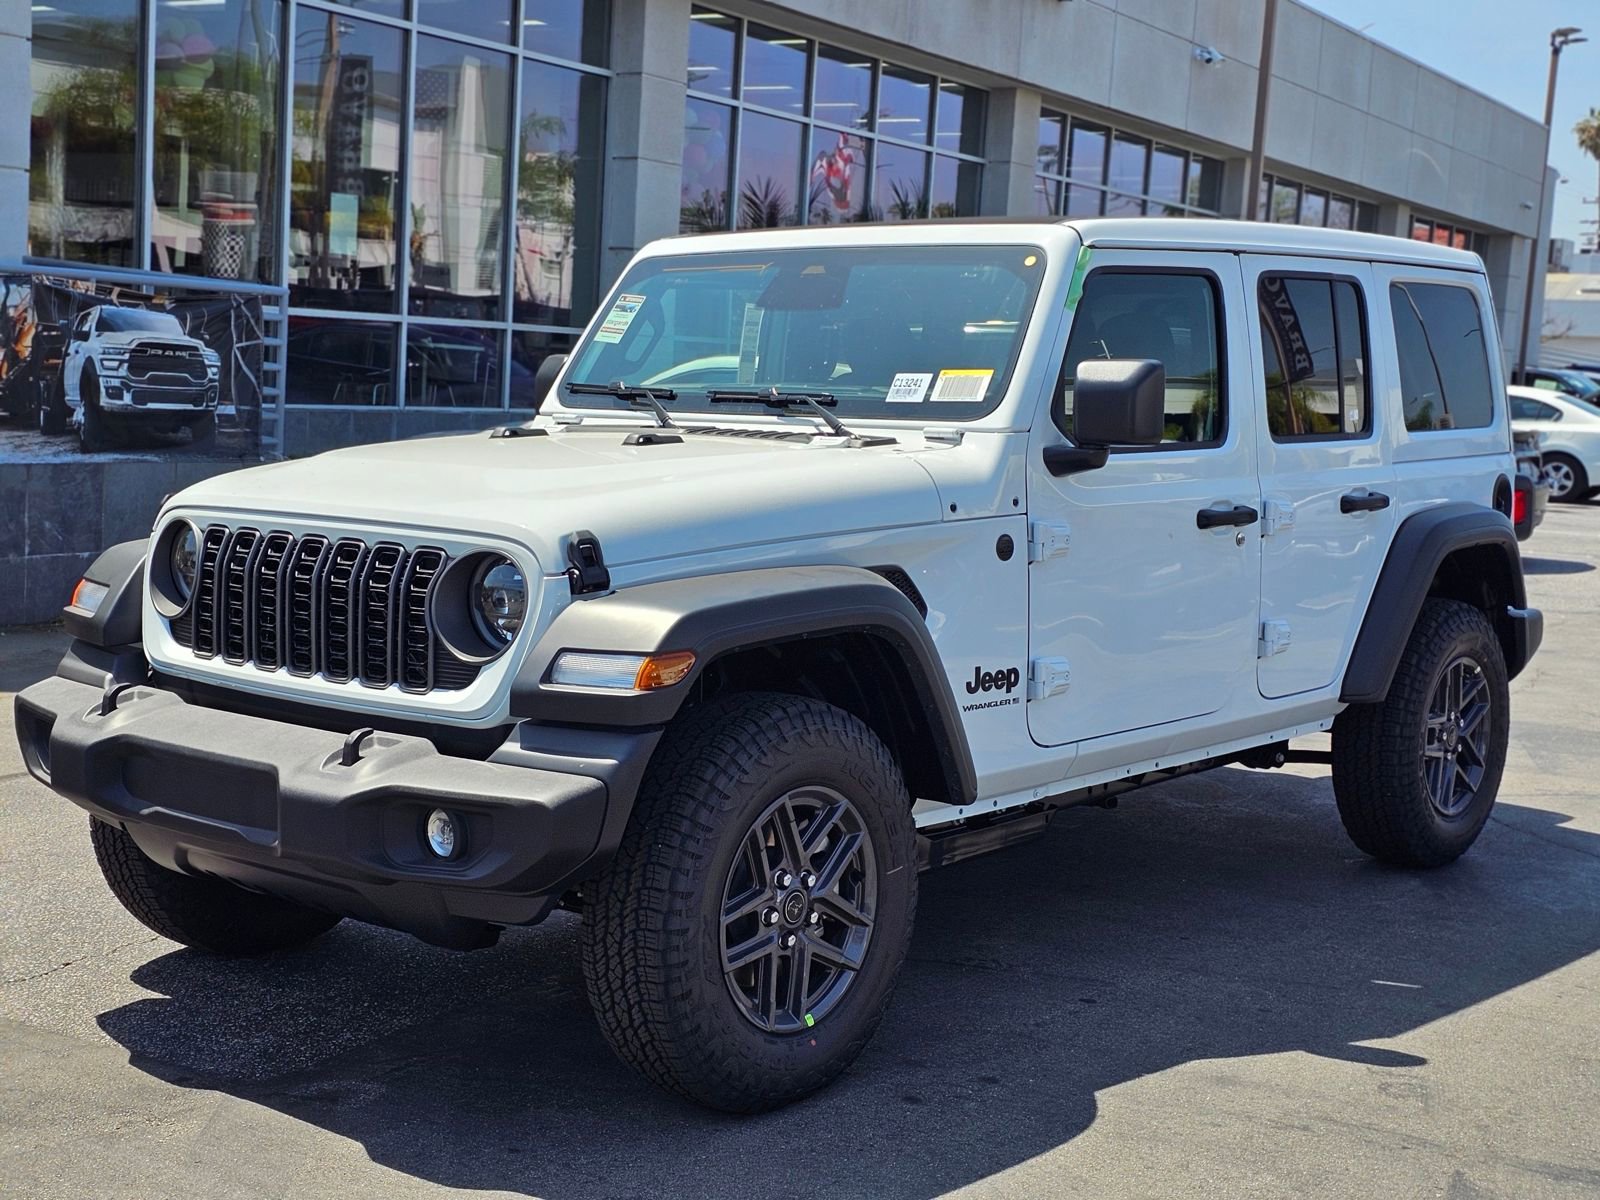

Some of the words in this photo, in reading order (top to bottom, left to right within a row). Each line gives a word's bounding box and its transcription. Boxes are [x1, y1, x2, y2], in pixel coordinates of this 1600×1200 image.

[893, 378, 924, 388] C13241
[965, 665, 1020, 695] Jeep
[962, 698, 1011, 712] WRANGLER
